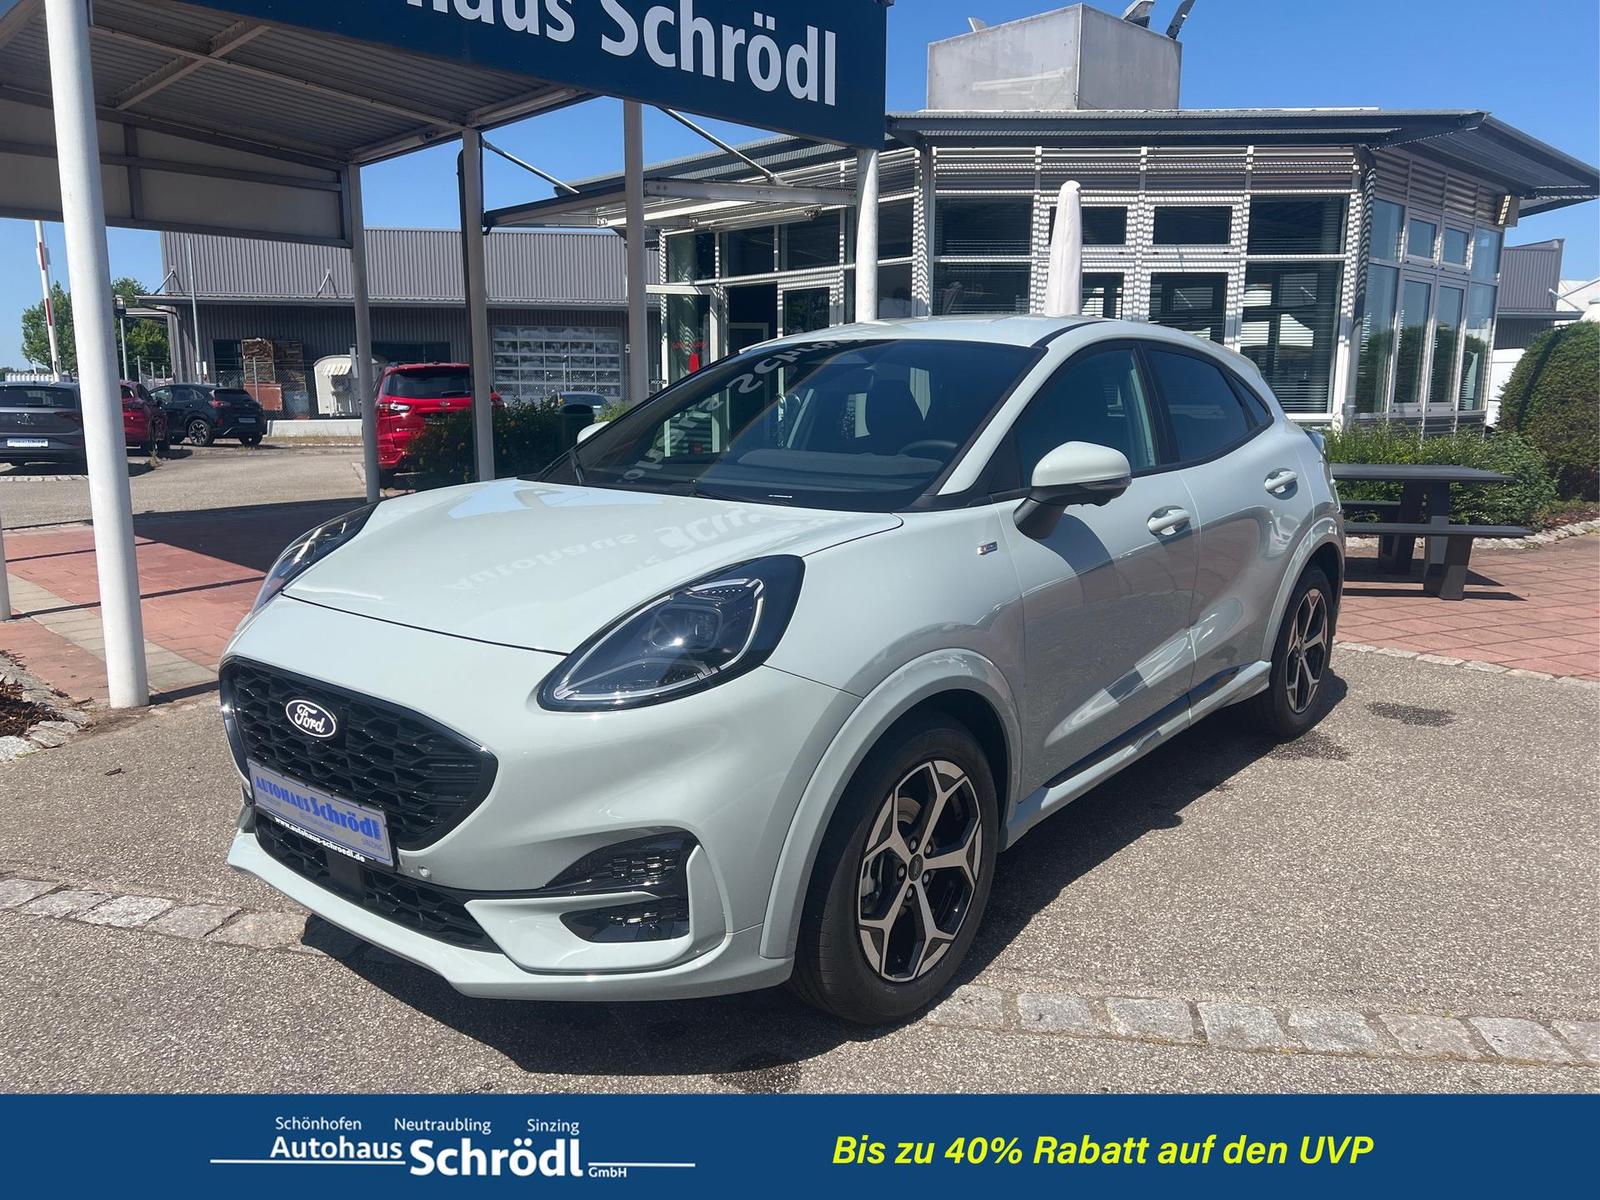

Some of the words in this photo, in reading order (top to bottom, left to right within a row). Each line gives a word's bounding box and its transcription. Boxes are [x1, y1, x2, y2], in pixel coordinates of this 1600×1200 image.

[408, 0, 575, 42] us
[601, 0, 836, 106] Schrödl
[295, 703, 326, 733] Ford
[256, 778, 311, 812] AUTOHAUS
[311, 797, 381, 840] Schrödl
